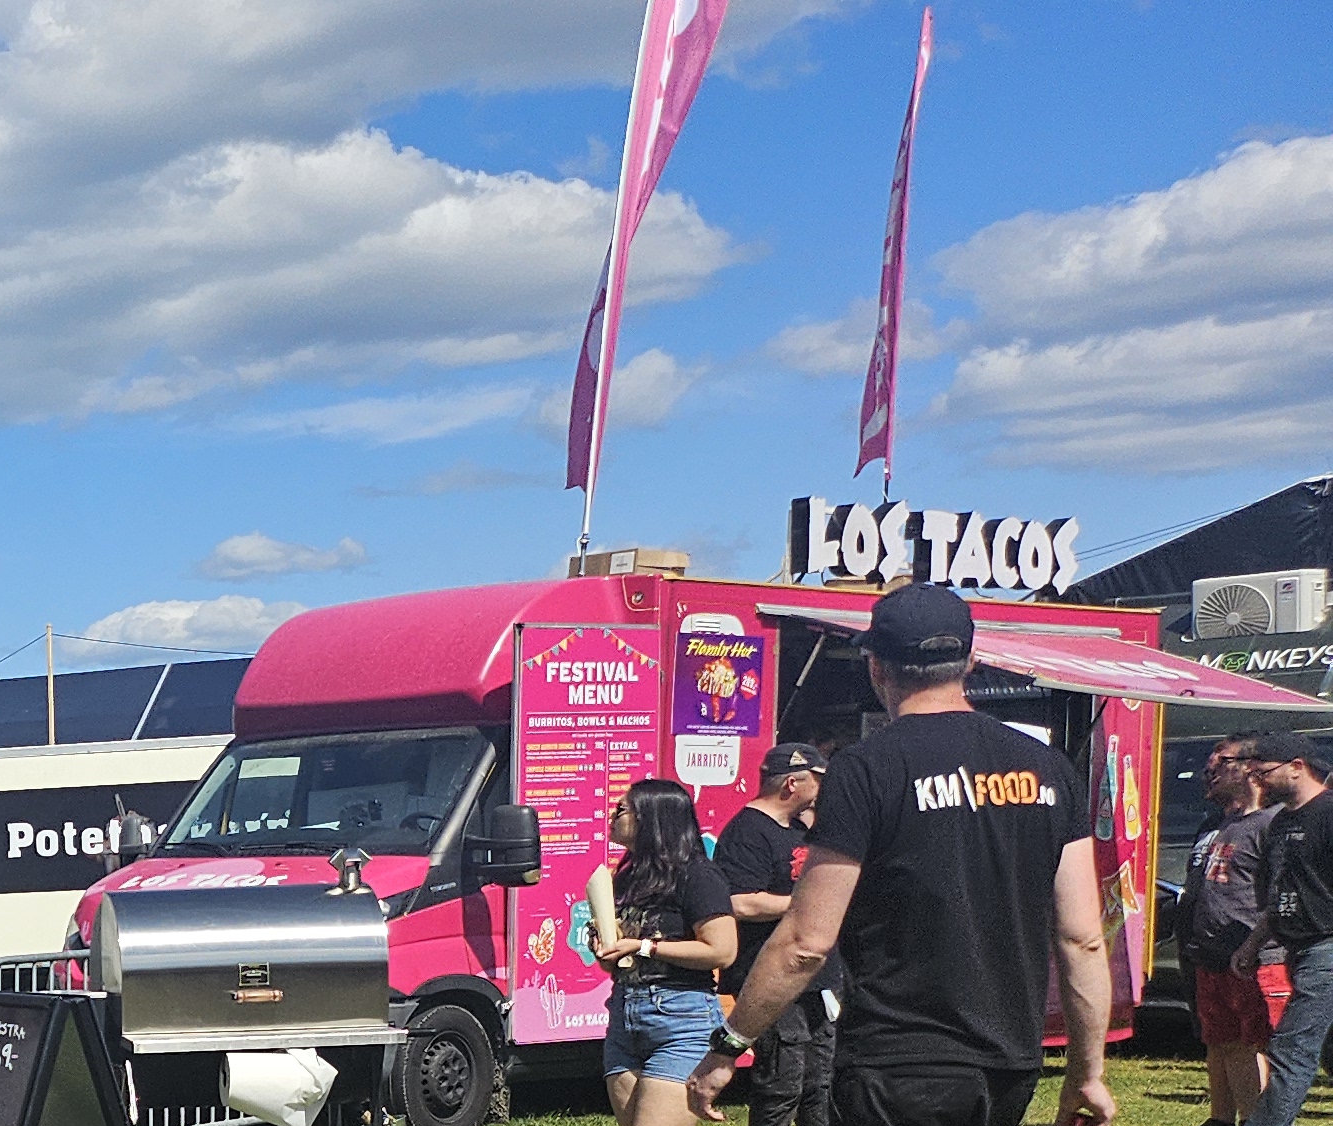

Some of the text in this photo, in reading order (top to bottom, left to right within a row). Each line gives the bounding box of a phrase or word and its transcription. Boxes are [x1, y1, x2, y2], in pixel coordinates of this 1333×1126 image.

[793, 496, 1079, 596] LOS TACOS
[546, 661, 639, 683] FESTIVAL
[568, 684, 624, 705] MENU
[528, 716, 575, 728] BURRITOS,
[577, 715, 606, 727] BOWLS
[616, 715, 650, 726] NACHOS
[609, 742, 638, 750] EXTRAS
[686, 752, 728, 768] JARRITOS
[914, 773, 962, 812] KM
[565, 1012, 610, 1028] LOS TACO
